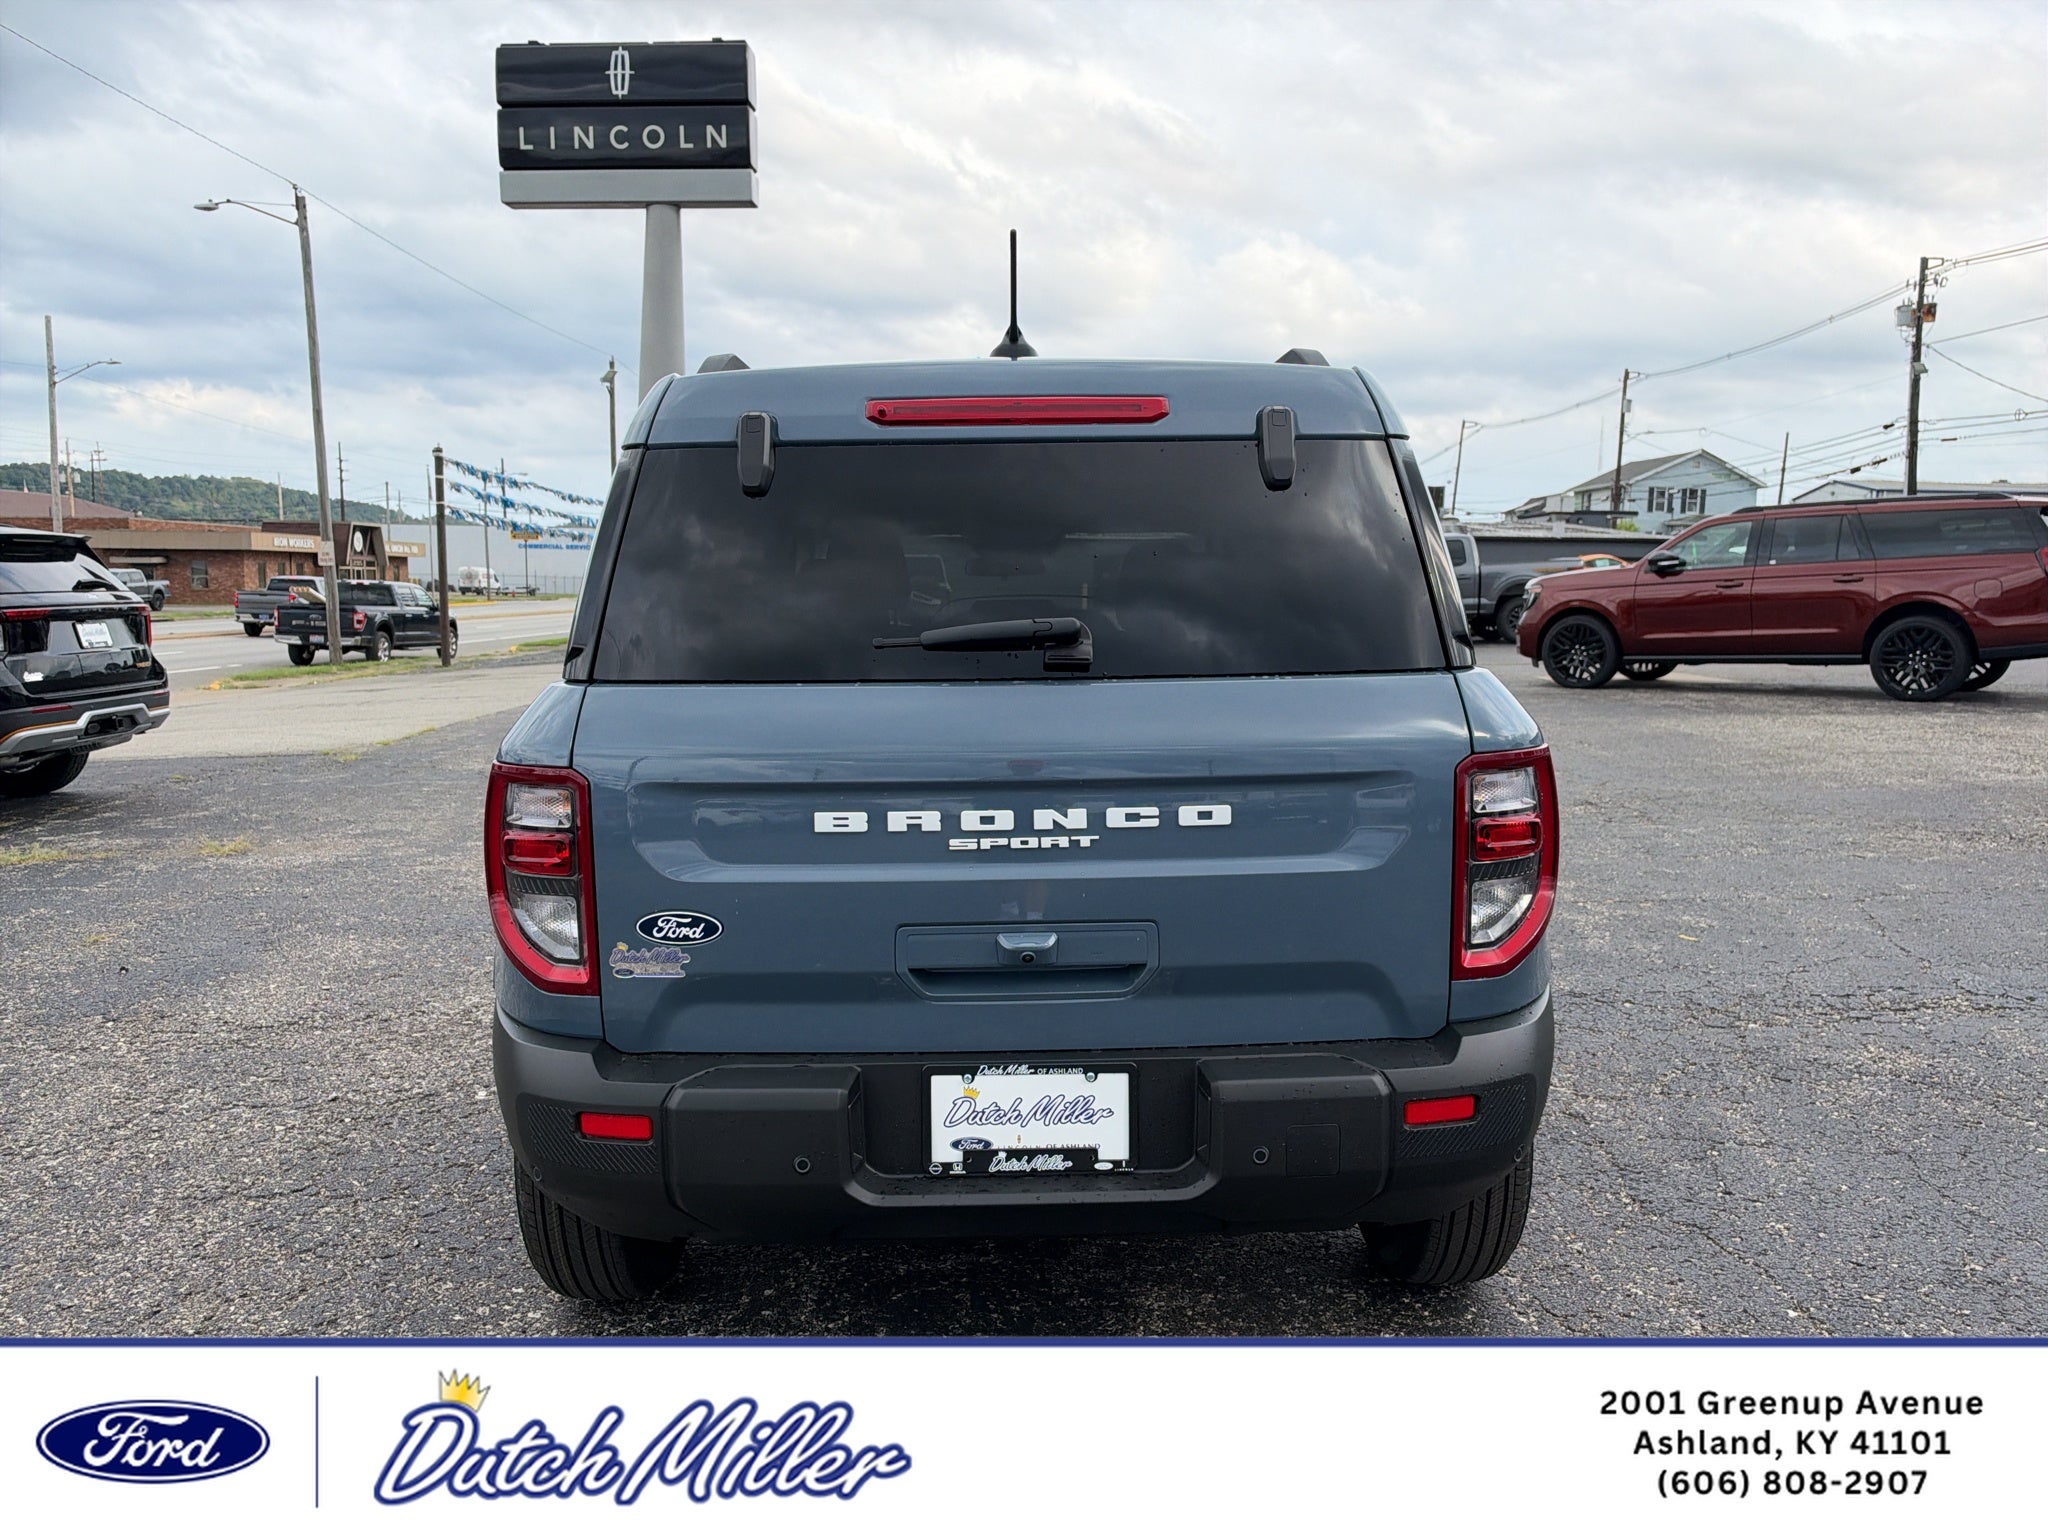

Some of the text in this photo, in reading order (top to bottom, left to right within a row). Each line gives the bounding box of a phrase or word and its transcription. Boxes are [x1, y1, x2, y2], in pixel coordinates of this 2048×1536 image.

[518, 124, 727, 150] LINCOLN
[289, 538, 315, 548] WORKERS
[813, 804, 1232, 833] BRONCO
[948, 835, 1100, 851] SPORT
[652, 916, 706, 939] Ford
[977, 1064, 1084, 1076] Dutch Miller OF ASHLAND
[943, 1094, 1115, 1128] Dutch Miller
[958, 1139, 985, 1149] Ford
[988, 1154, 1073, 1172] Dutch Miller
